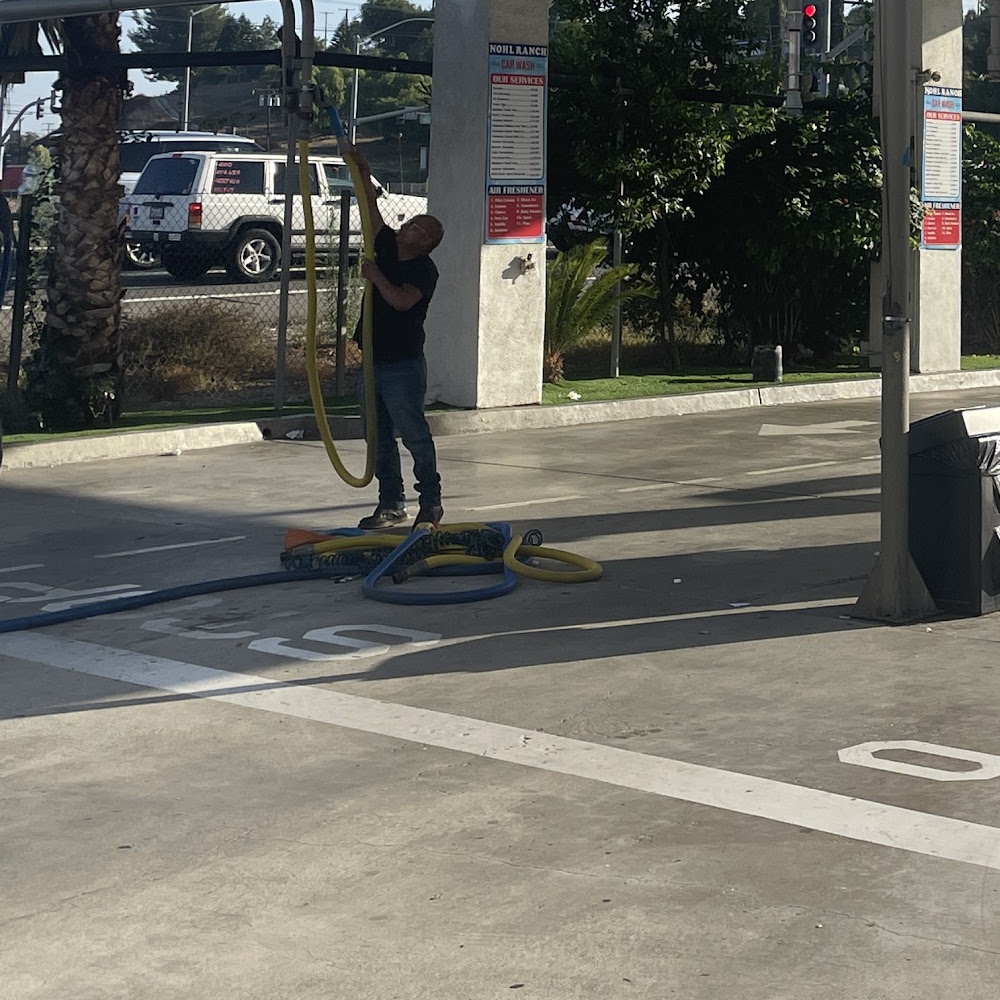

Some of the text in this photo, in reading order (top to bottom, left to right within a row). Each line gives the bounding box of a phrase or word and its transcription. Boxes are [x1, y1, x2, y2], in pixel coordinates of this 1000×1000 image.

[489, 44, 547, 56] NOHL RANCH
[501, 59, 536, 71] CAR WASH
[492, 75, 544, 85] OUR SERVICES
[489, 186, 543, 195] AIR FRESHENER
